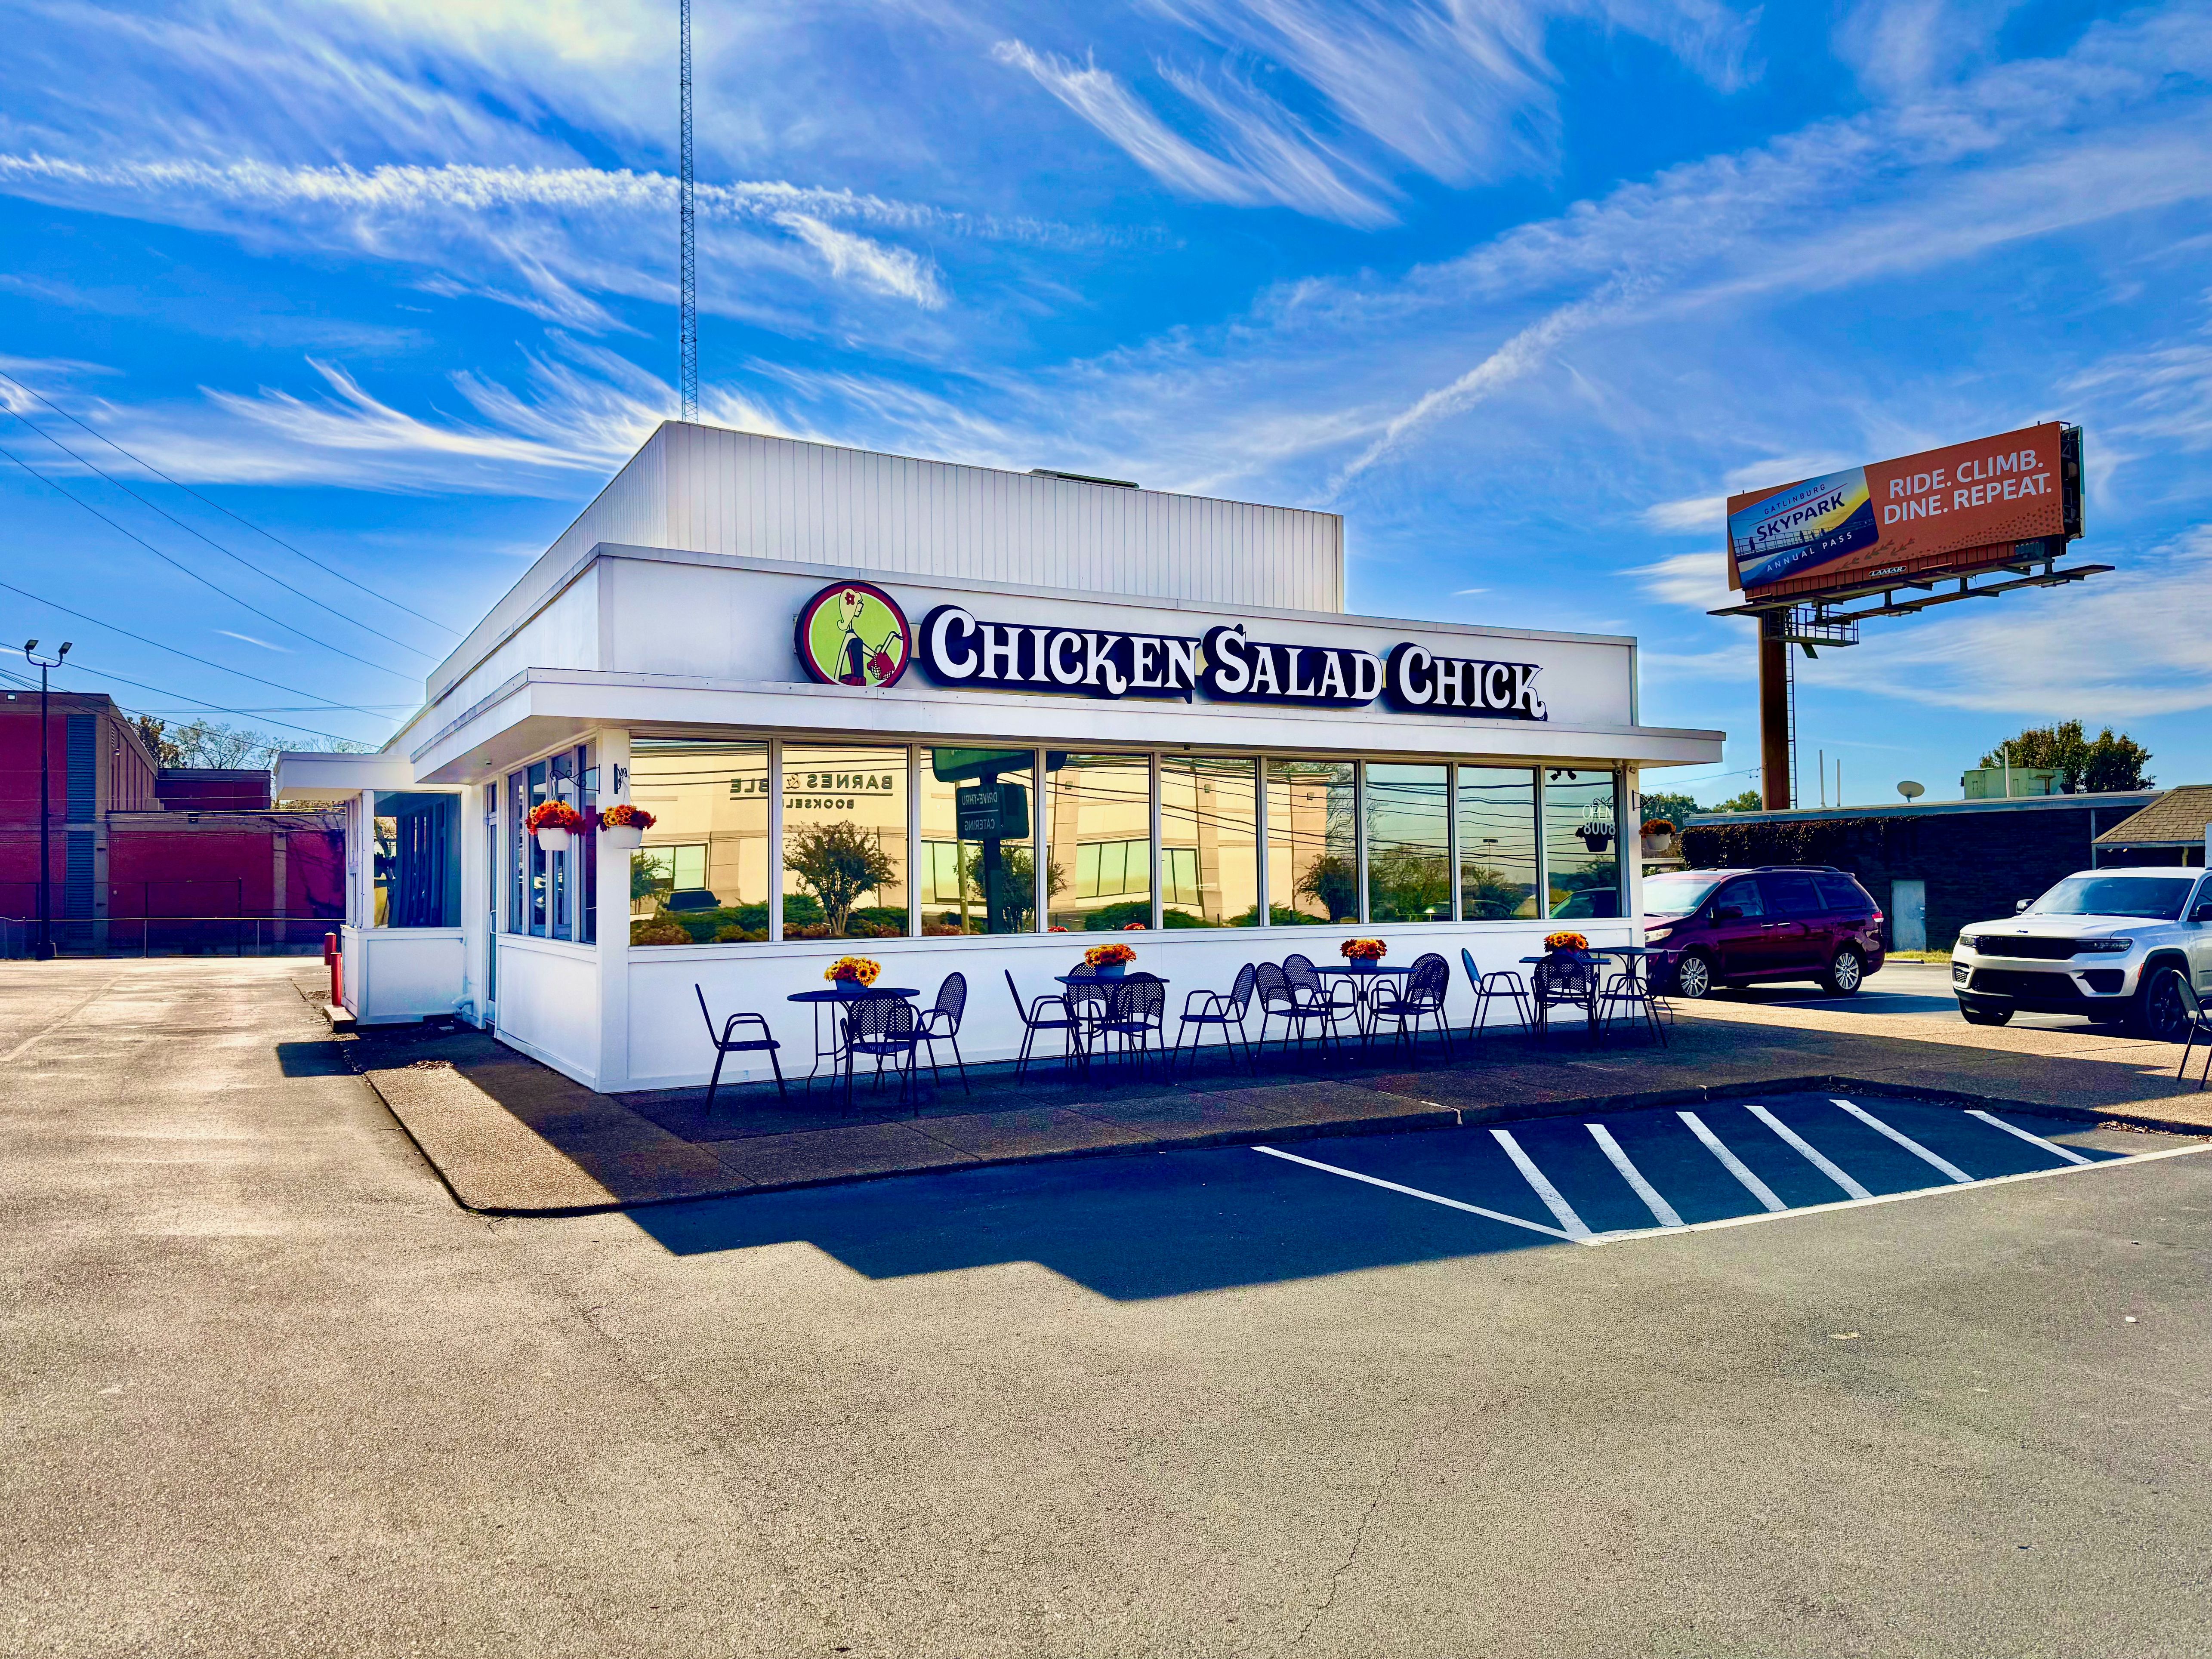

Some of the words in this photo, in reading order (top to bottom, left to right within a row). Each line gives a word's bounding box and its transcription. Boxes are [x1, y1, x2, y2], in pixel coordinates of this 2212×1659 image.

[1890, 468, 1952, 499] RIDE.
[1956, 450, 2044, 483] CLIMB.
[1757, 491, 1845, 542] SKYPARK
[1765, 484, 1825, 515] GATLINBURG
[1884, 495, 1948, 525] DINE.
[1953, 472, 2052, 510] REPEAT.
[1767, 547, 1815, 572] ANNUAL
[1822, 532, 1852, 549] PASS
[1872, 566, 1903, 576] LAMAR
[931, 609, 1197, 694] CHICKEN
[1215, 630, 1382, 700] SALAD
[1399, 645, 1546, 718] CHICK
[1582, 804, 1613, 820] OPEN
[1583, 821, 1616, 835] 8008
